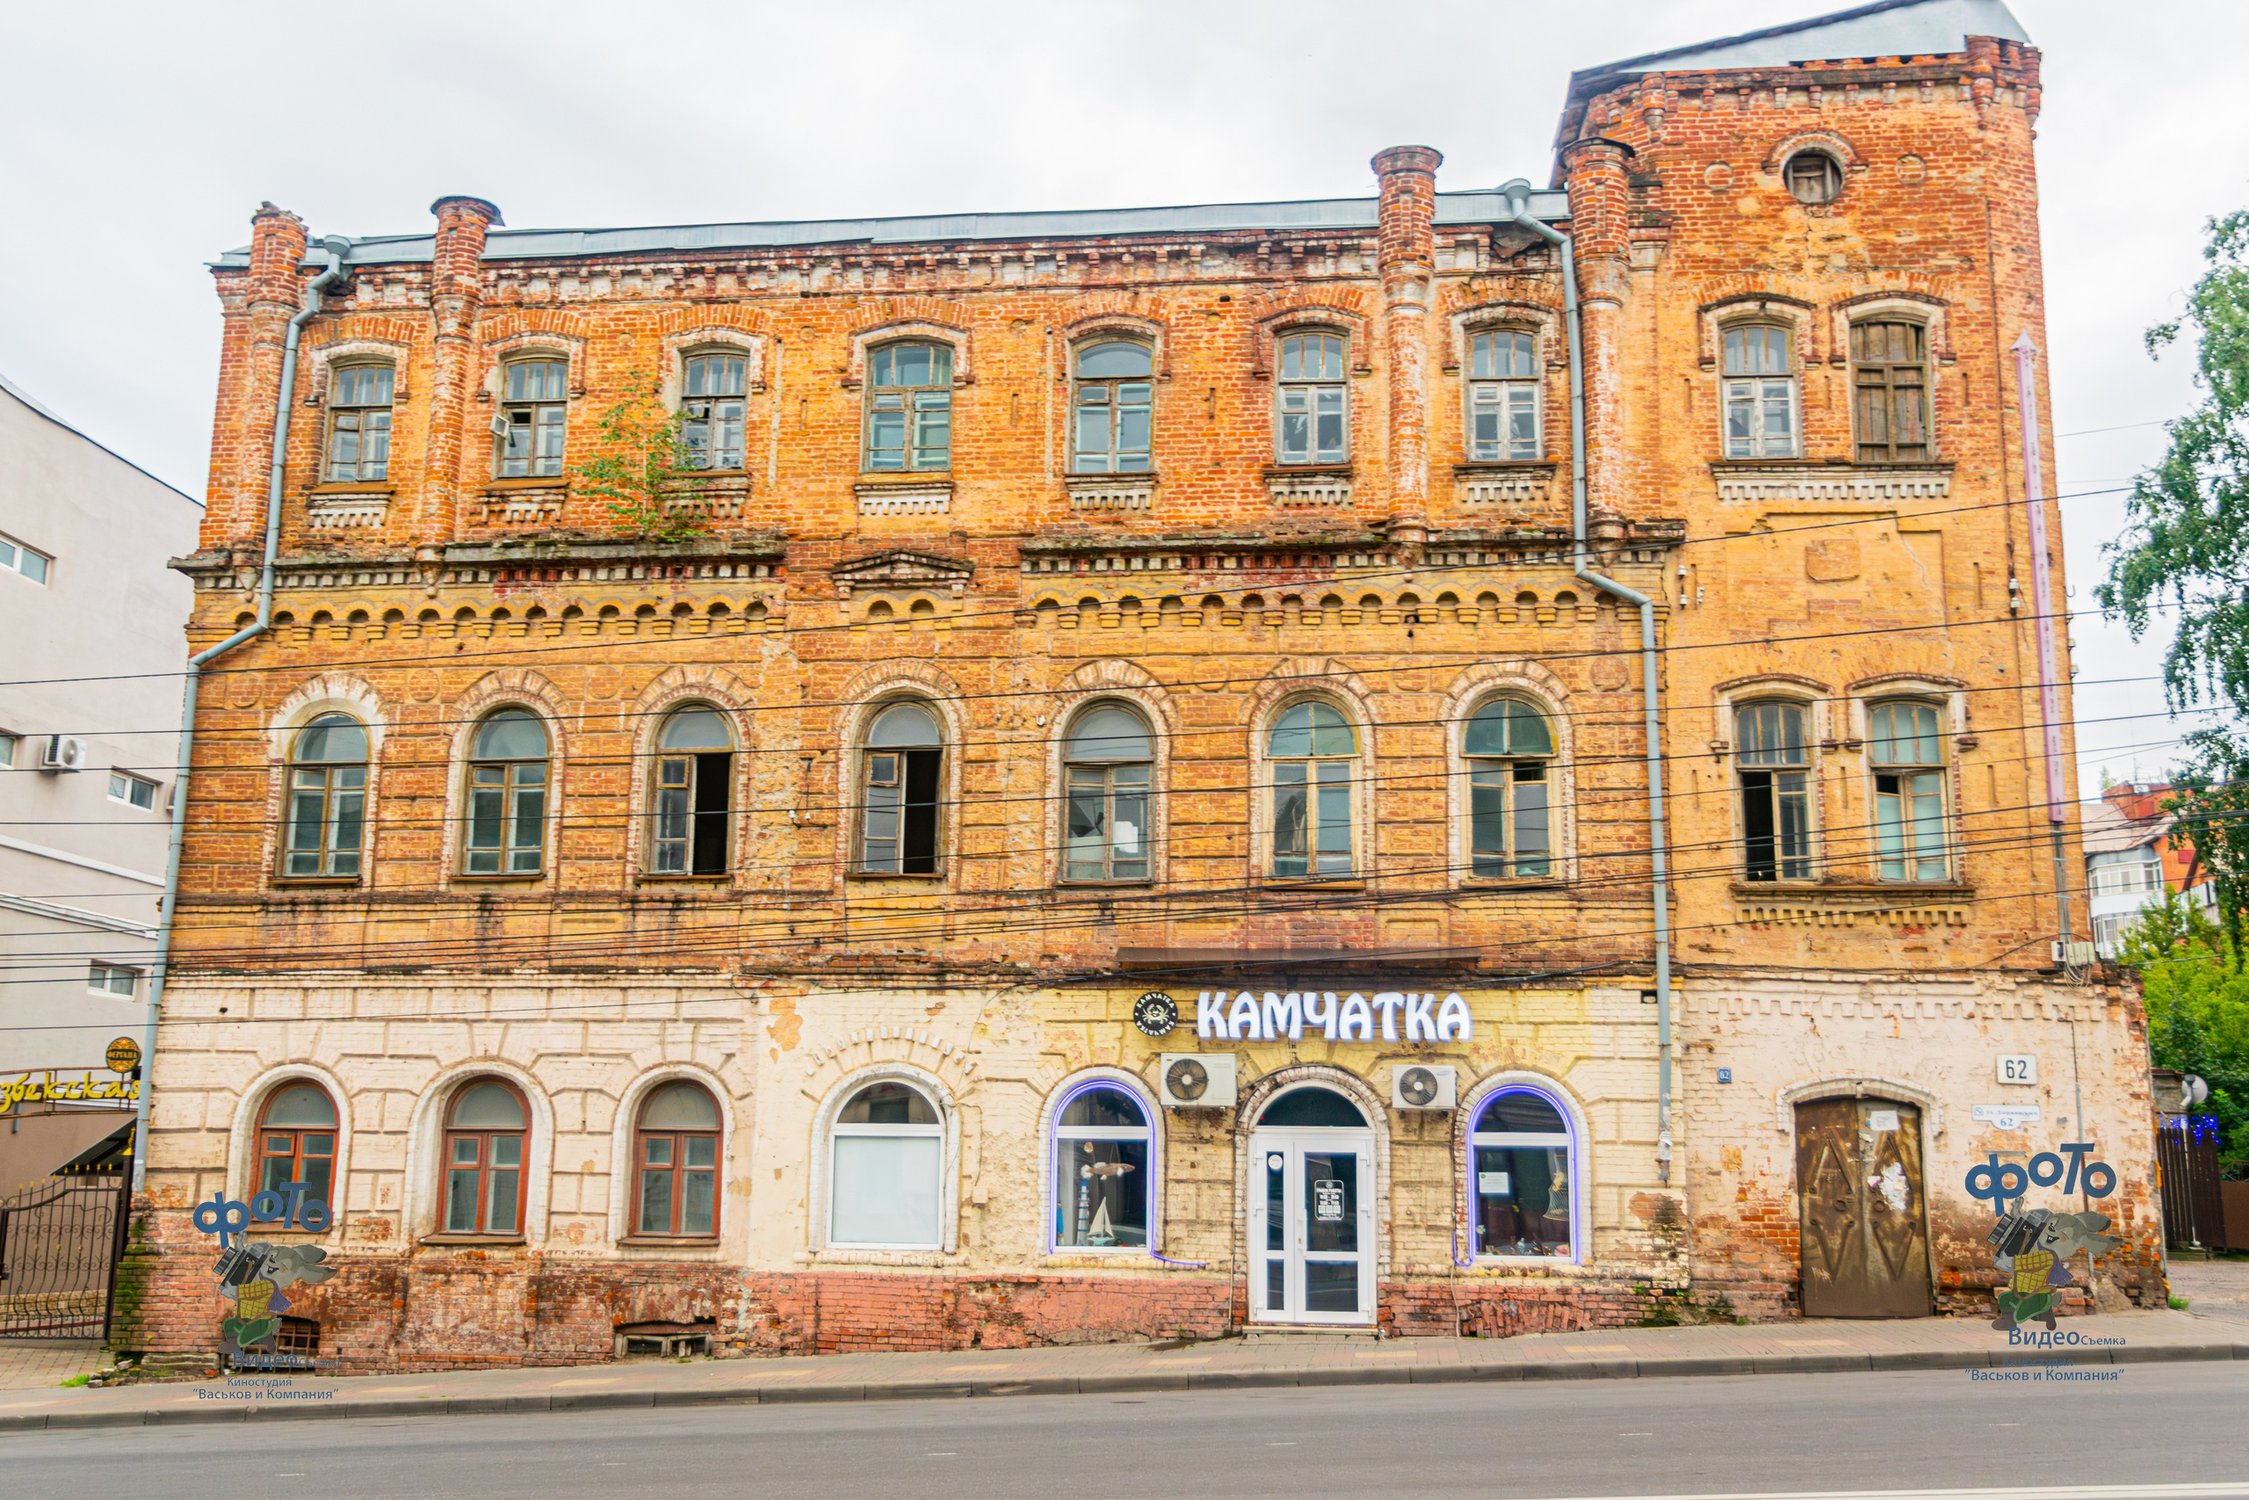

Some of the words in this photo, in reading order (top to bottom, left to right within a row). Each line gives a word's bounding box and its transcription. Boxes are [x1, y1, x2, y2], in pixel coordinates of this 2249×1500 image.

[1198, 991, 1471, 1041] КАМЧАТКА
[2005, 1059, 2028, 1079] 62
[2000, 1117, 2014, 1127] 62
